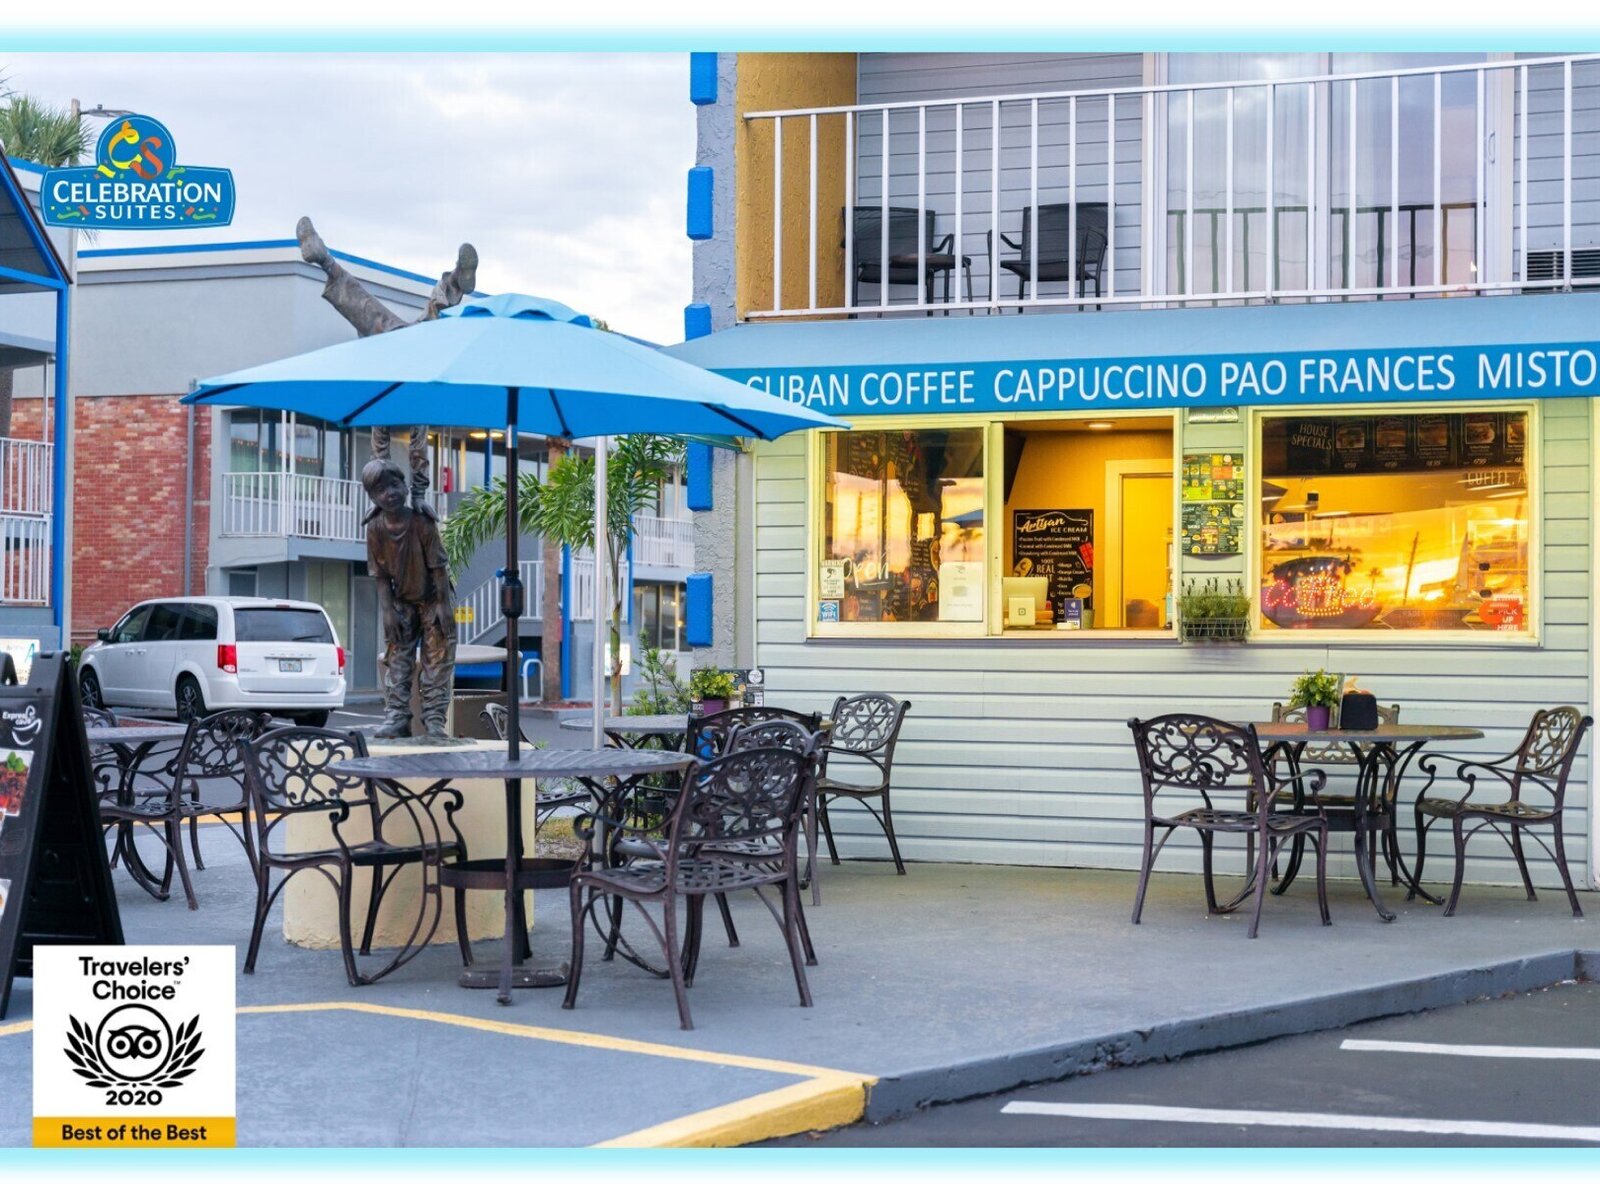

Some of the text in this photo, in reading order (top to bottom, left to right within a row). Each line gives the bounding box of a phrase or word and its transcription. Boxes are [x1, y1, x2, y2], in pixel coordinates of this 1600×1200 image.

[860, 370, 975, 406] COFFEE
[994, 362, 1207, 402] CAPPUCCINO
[1221, 360, 1287, 396] PAO
[1300, 354, 1455, 394] FRANCES
[1478, 349, 1597, 389] MISTO
[1299, 423, 1329, 438] HOUSE
[1291, 434, 1332, 450] SPECIALS
[1020, 518, 1066, 533] Artisan
[1050, 526, 1088, 534] ICE CREAM
[1036, 565, 1055, 574] REAL
[1502, 615, 1514, 624] UP
